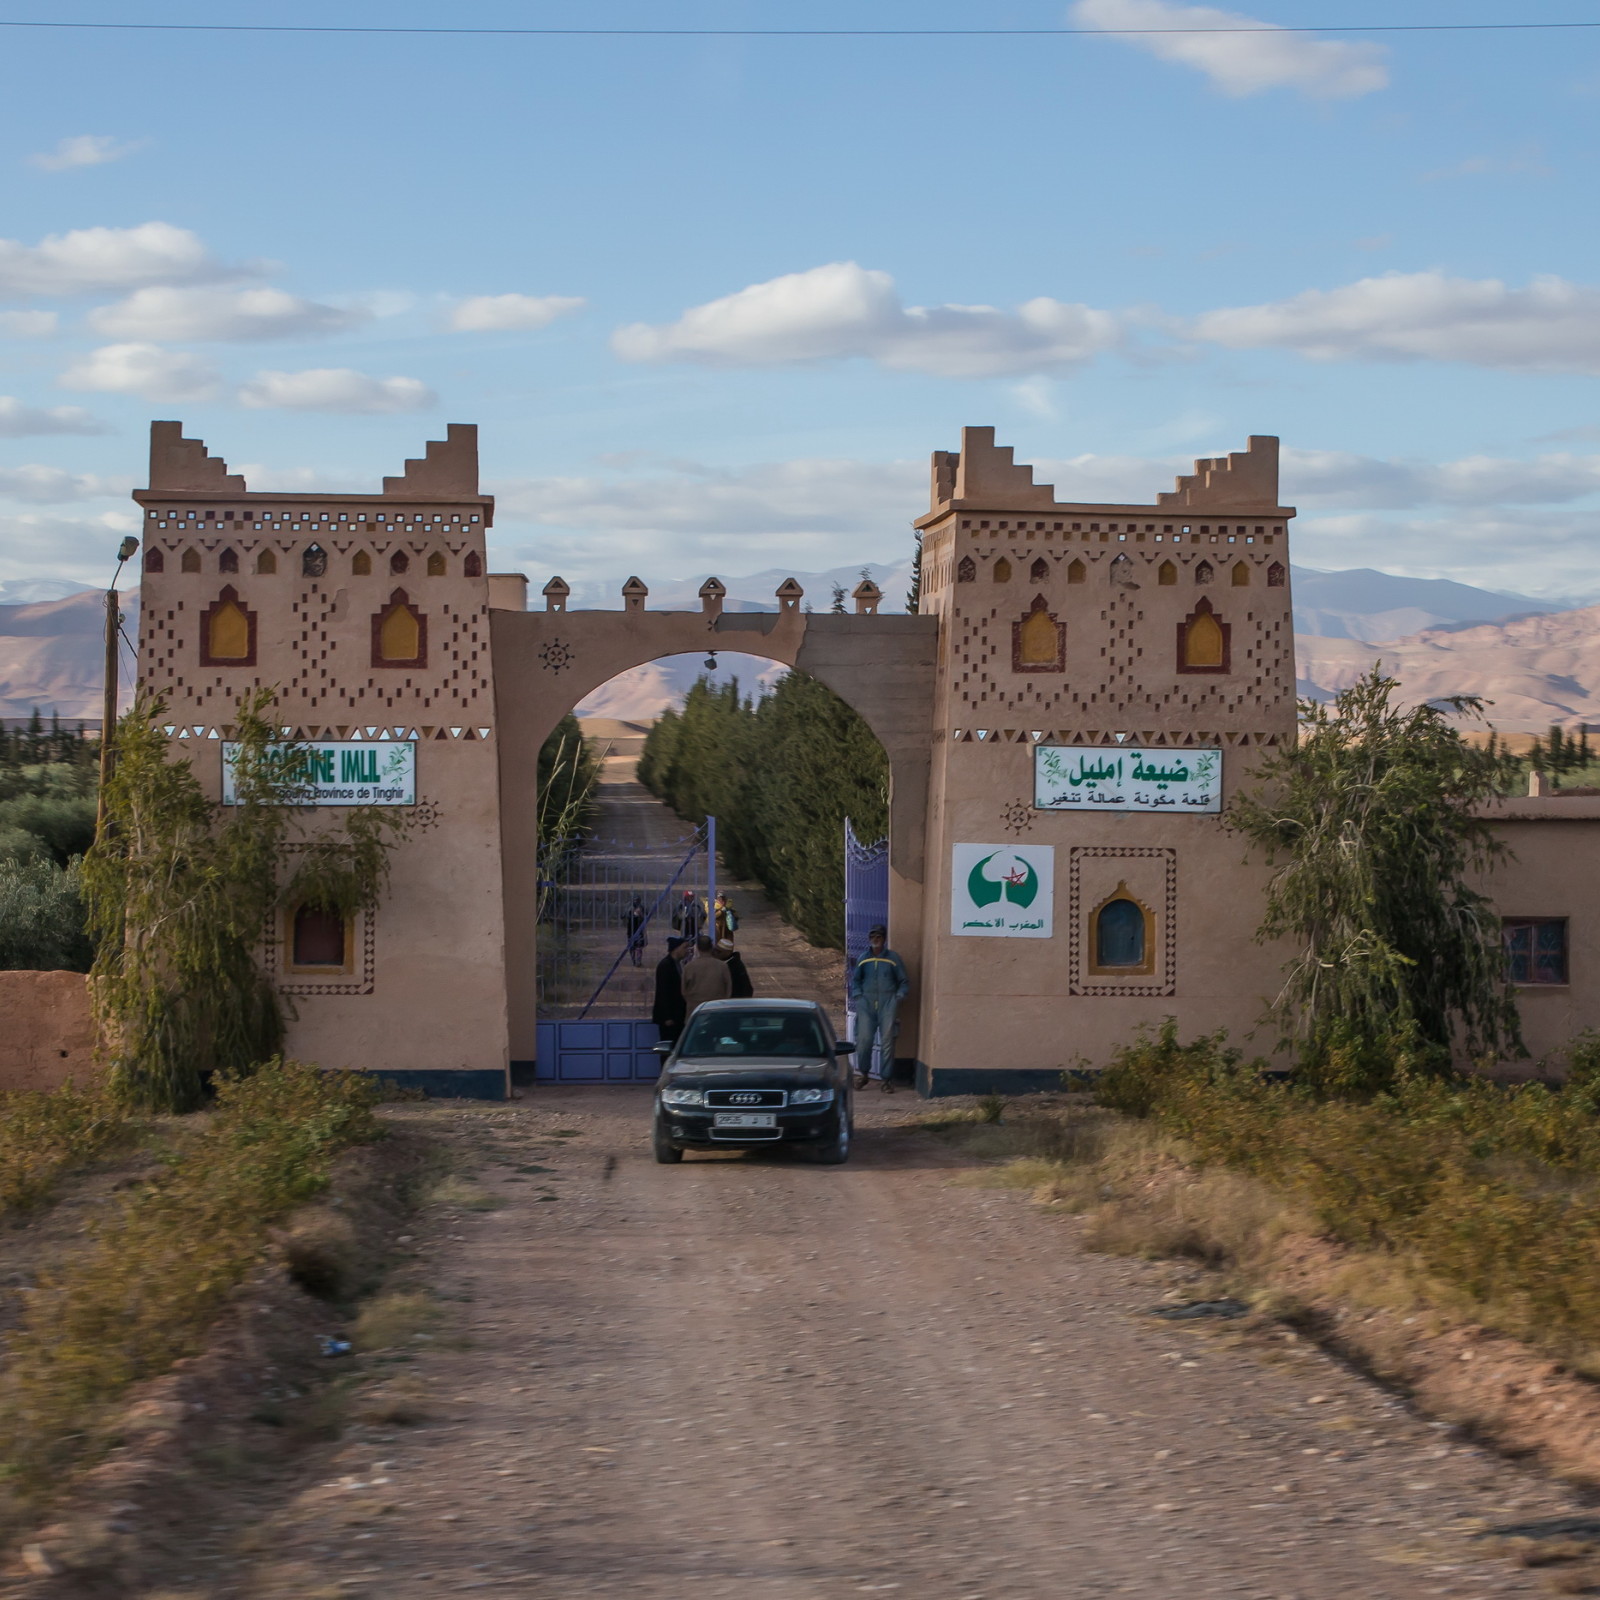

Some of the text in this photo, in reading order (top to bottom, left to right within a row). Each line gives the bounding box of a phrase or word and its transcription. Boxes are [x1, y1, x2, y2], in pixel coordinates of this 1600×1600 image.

[341, 749, 381, 783] IMLIL
[1068, 751, 1189, 790] ضيعة إمليل
[314, 786, 355, 799] Province
[357, 786, 370, 799] de
[372, 786, 405, 801] Tinghir
[1047, 791, 1082, 806] تنغير
[1087, 790, 1126, 804] عمالة
[1181, 792, 1211, 806] قلعة
[1008, 918, 1044, 931] المغرب
